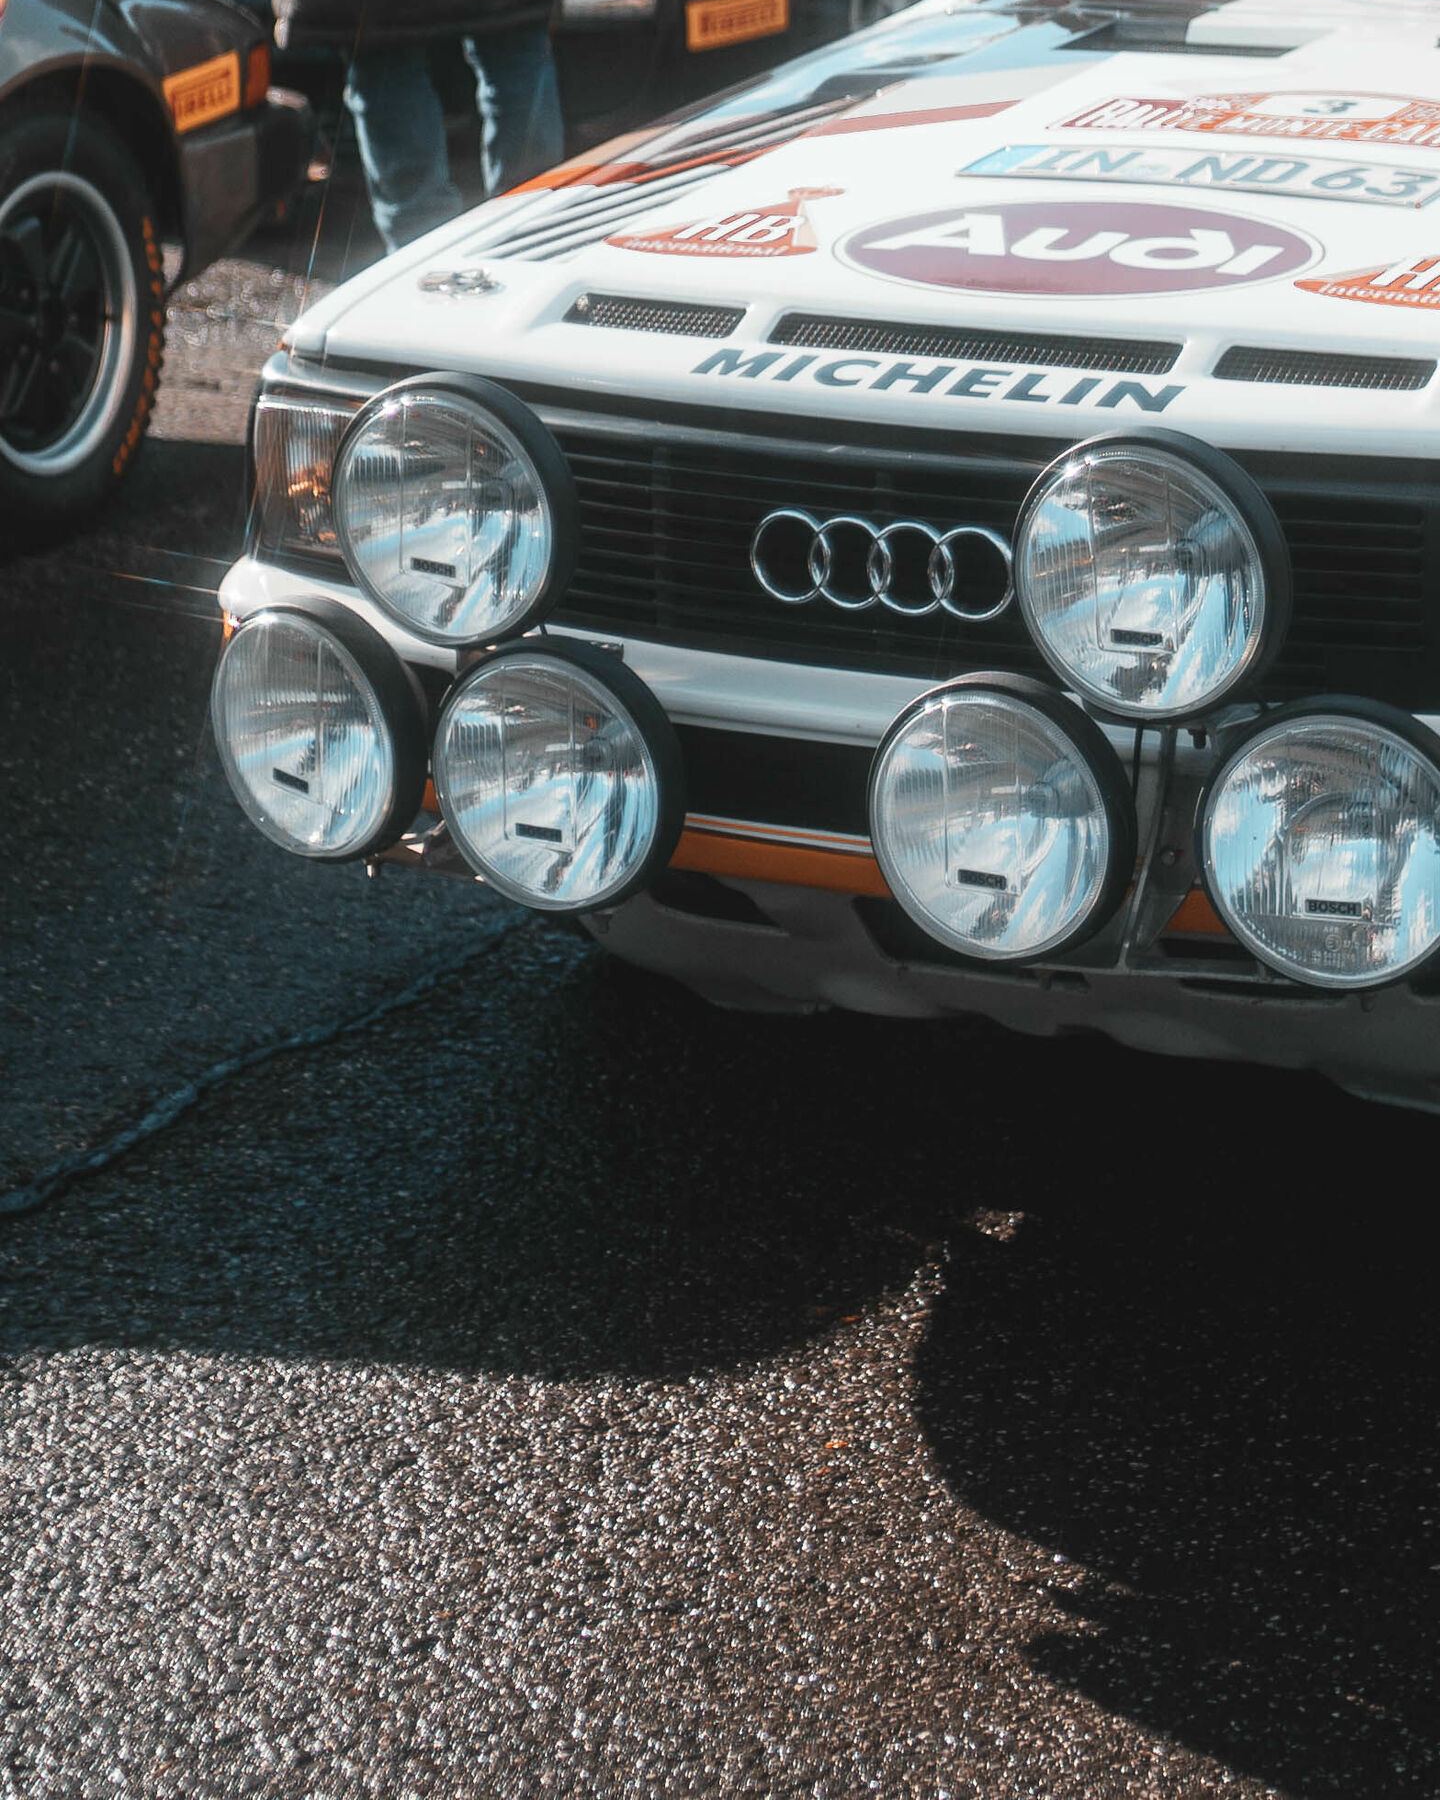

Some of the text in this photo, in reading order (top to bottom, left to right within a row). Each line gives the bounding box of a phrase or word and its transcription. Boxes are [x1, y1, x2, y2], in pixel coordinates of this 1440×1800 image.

[1303, 101, 1358, 114] 3
[1020, 150, 1437, 198] IN ND 63
[672, 212, 806, 243] HB
[623, 237, 789, 256] international
[862, 212, 1284, 275] Audi
[690, 347, 1189, 413] MICHELIN
[412, 558, 454, 575] BOSCH
[960, 870, 1007, 889] BOSCH
[1308, 901, 1358, 916] BOSCH
